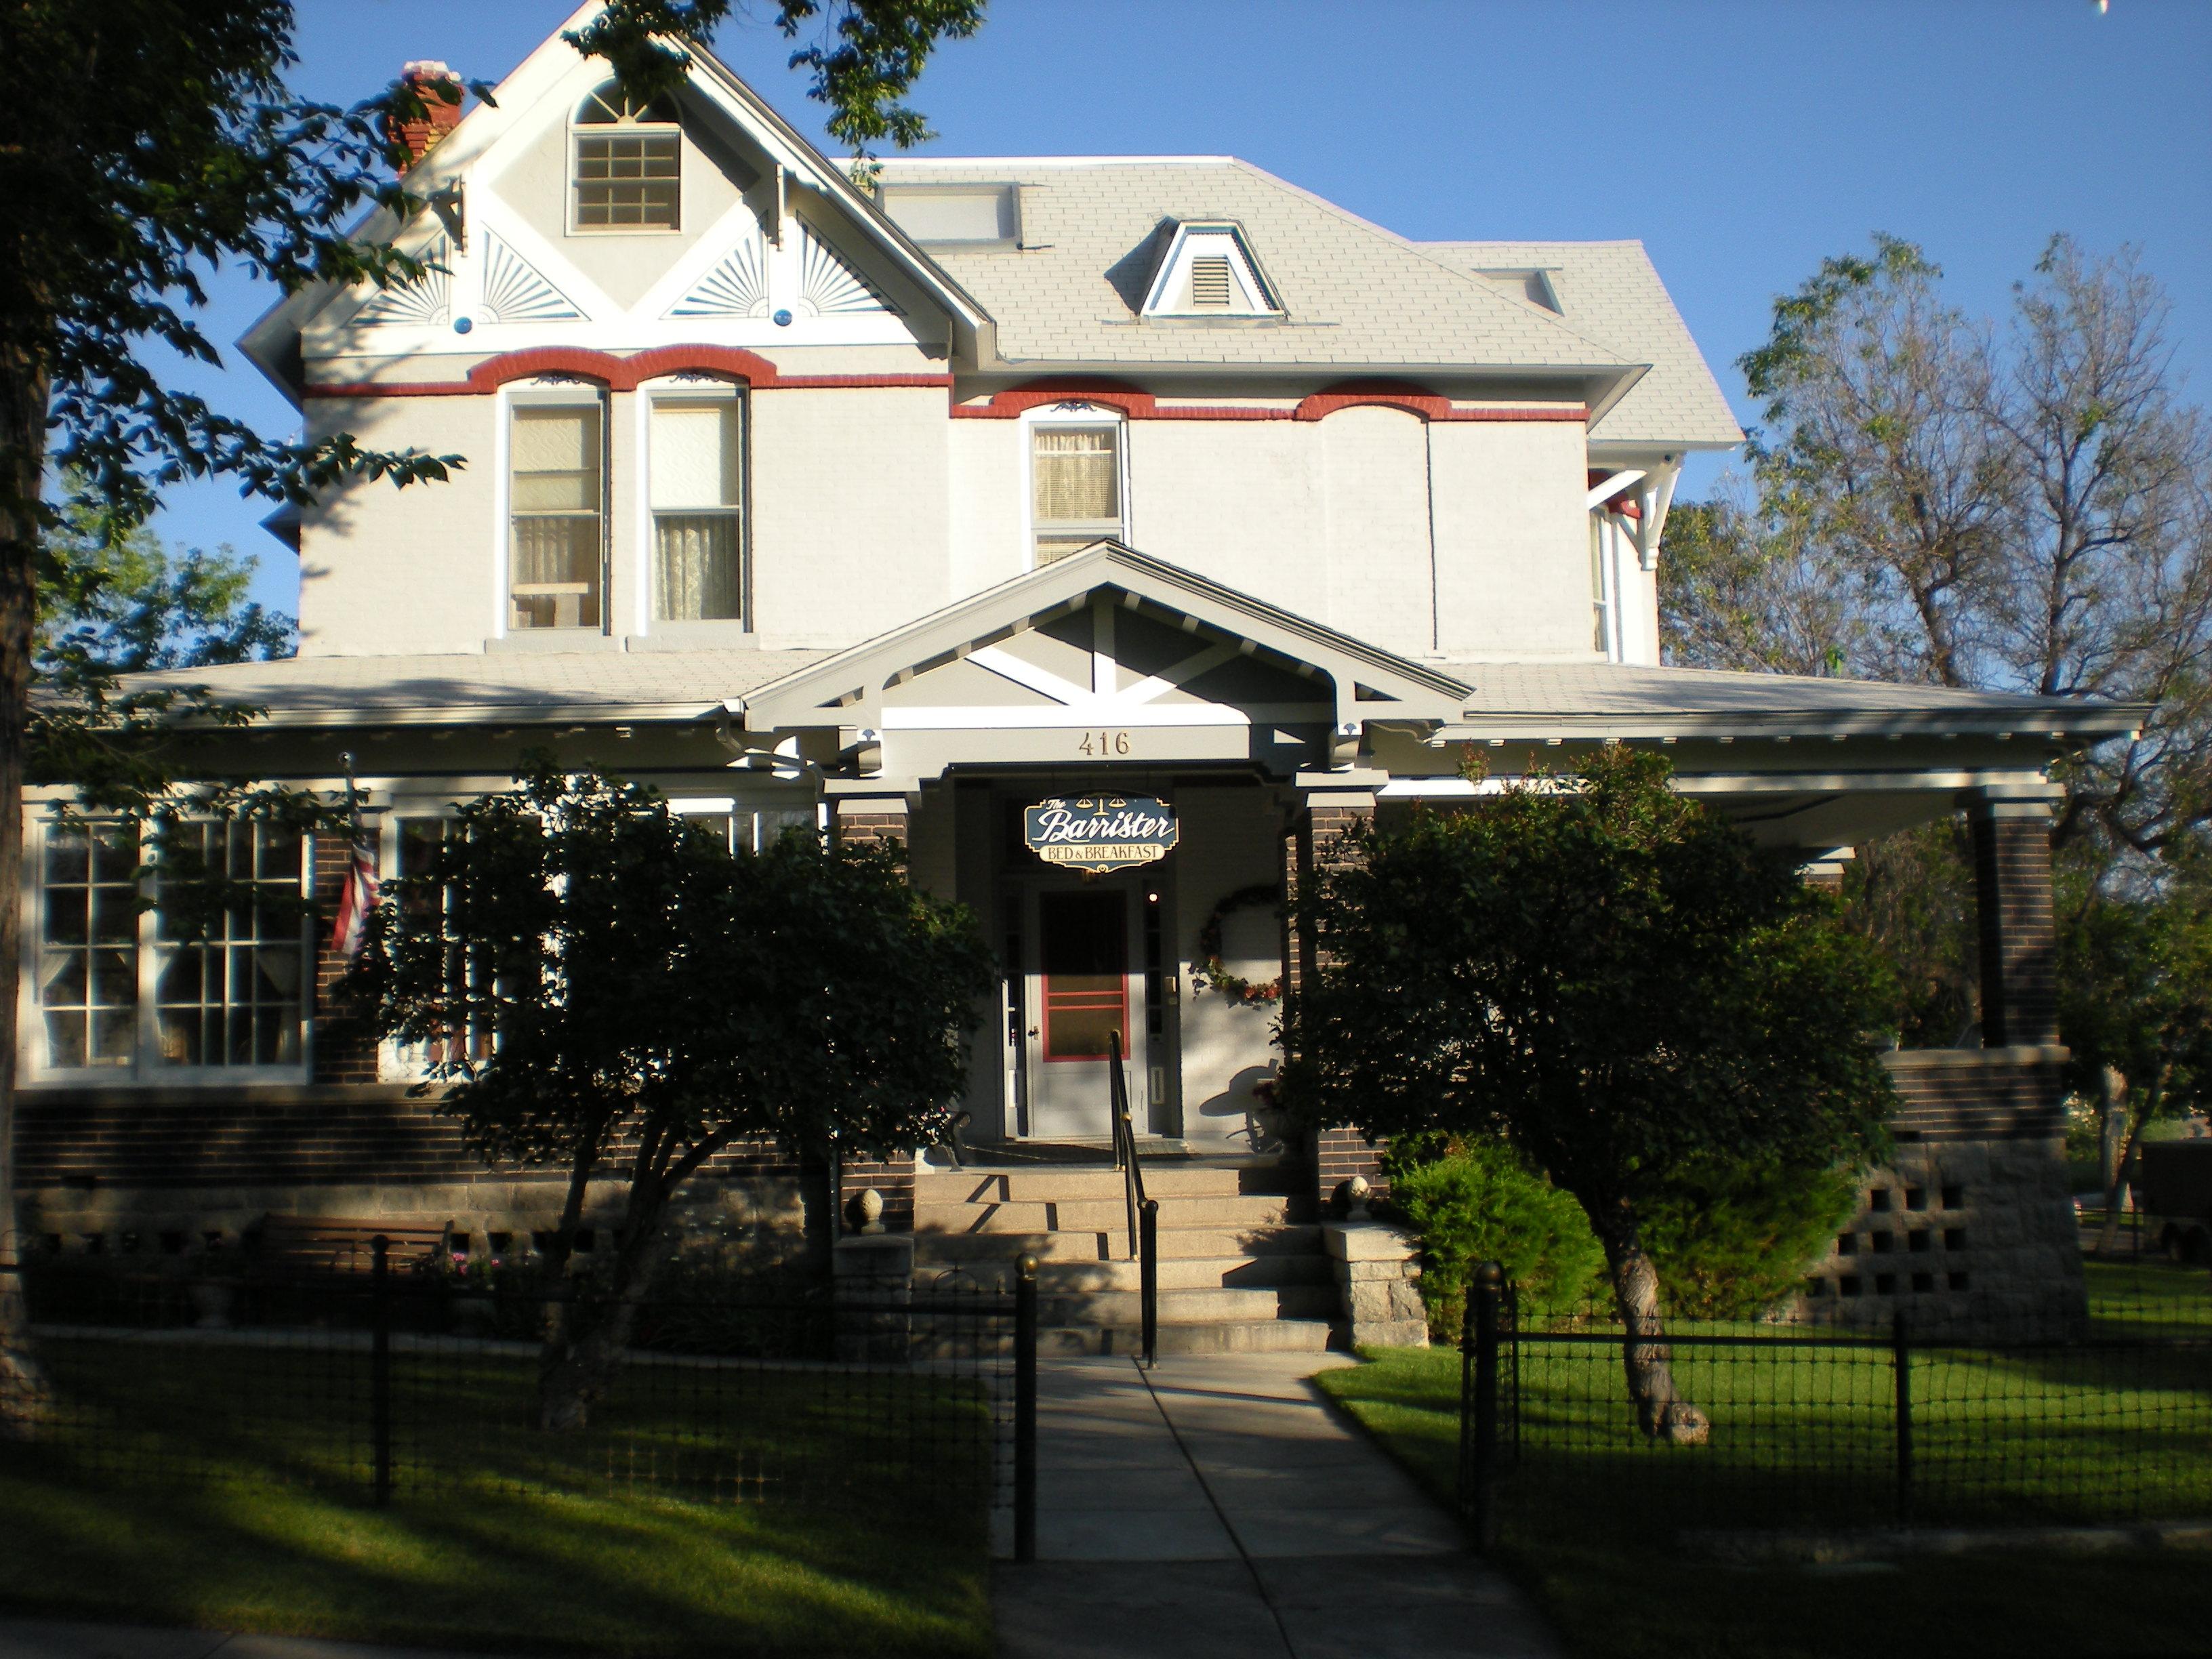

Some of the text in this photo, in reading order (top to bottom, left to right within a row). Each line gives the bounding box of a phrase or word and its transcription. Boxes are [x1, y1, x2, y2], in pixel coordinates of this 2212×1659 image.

[1079, 731, 1130, 756] 416
[1045, 799, 1067, 810] The
[1031, 809, 1175, 843] Barrister
[1048, 845, 1158, 859] BED & BREAKFAST
